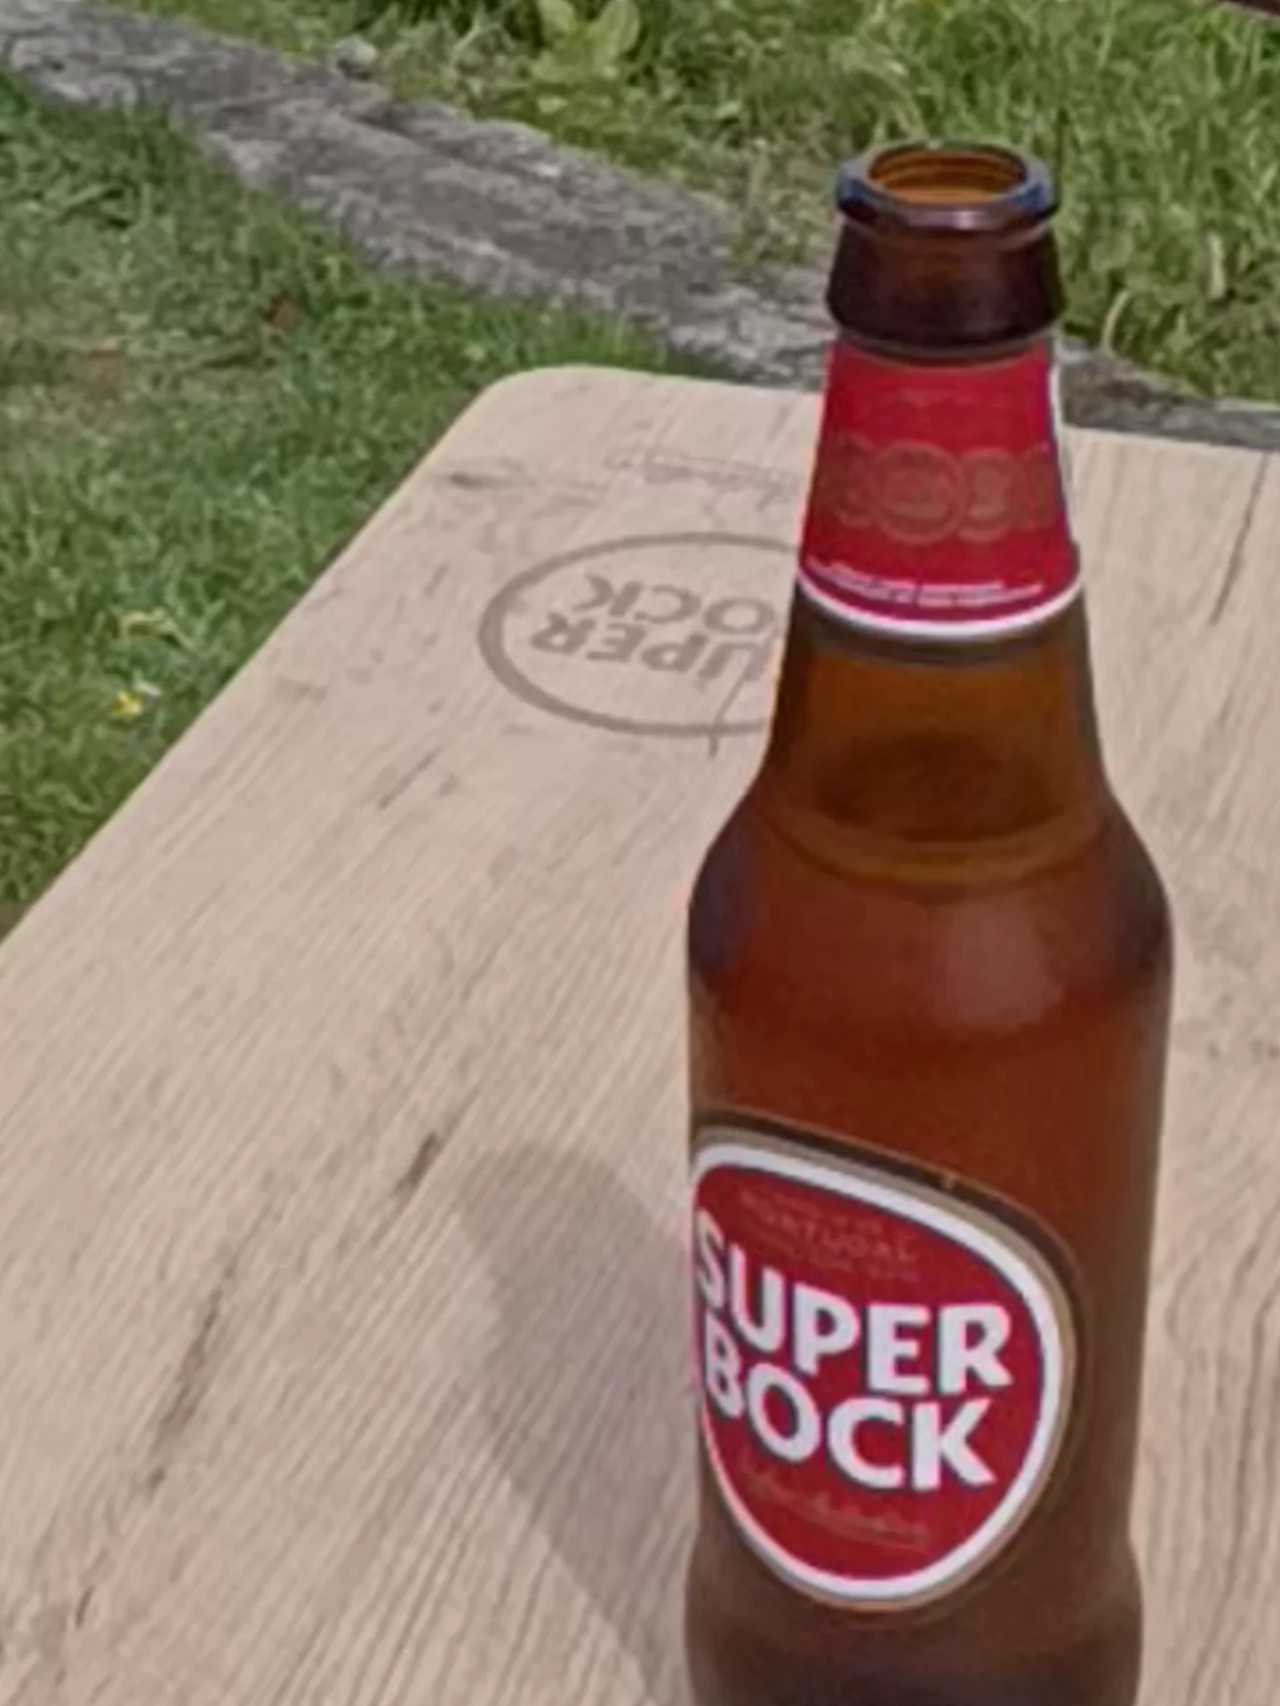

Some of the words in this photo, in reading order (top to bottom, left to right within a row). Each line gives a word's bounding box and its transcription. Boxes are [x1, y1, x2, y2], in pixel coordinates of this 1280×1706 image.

[531, 613, 773, 681] UPER
[572, 575, 775, 634] OCK
[699, 1208, 1013, 1394] SUPER
[704, 1318, 996, 1491] BOCK
